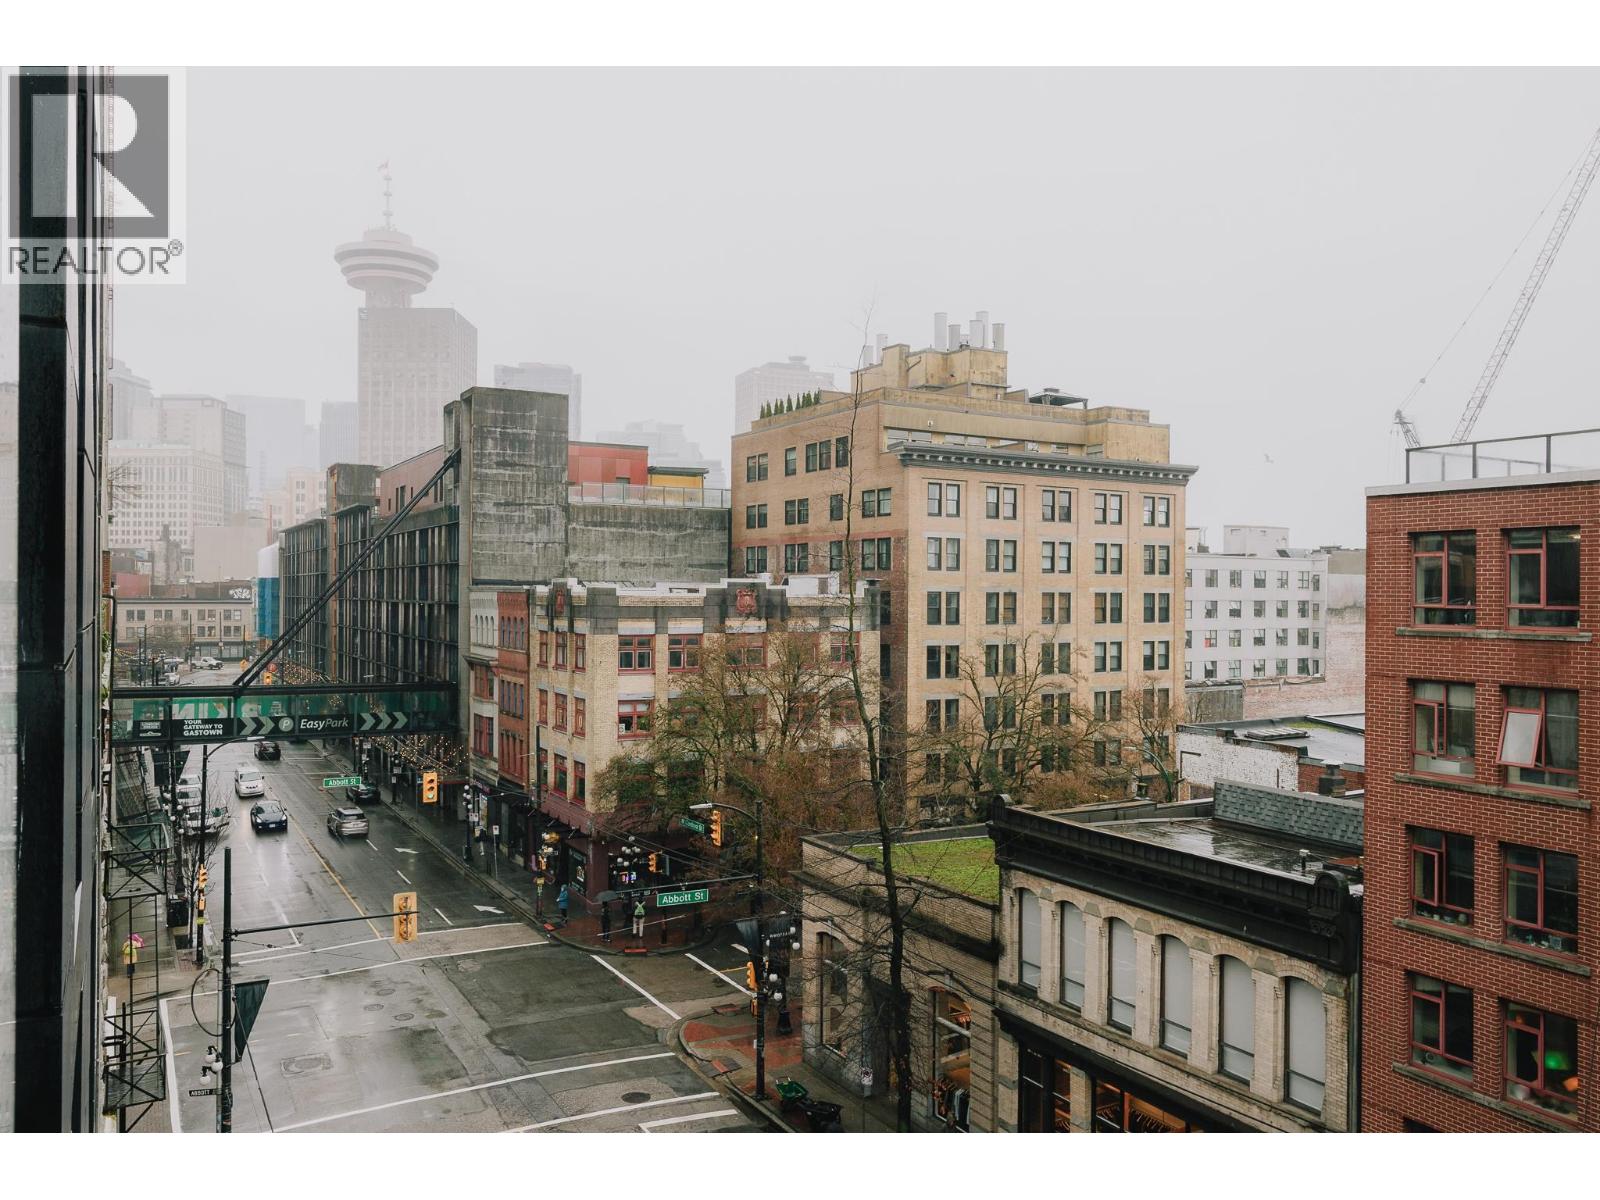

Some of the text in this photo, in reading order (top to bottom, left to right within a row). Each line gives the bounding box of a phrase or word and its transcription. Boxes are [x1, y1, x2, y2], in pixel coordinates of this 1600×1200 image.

[300, 717, 349, 731] EasyPark
[662, 892, 691, 904] Abbott
[694, 891, 704, 900] St
